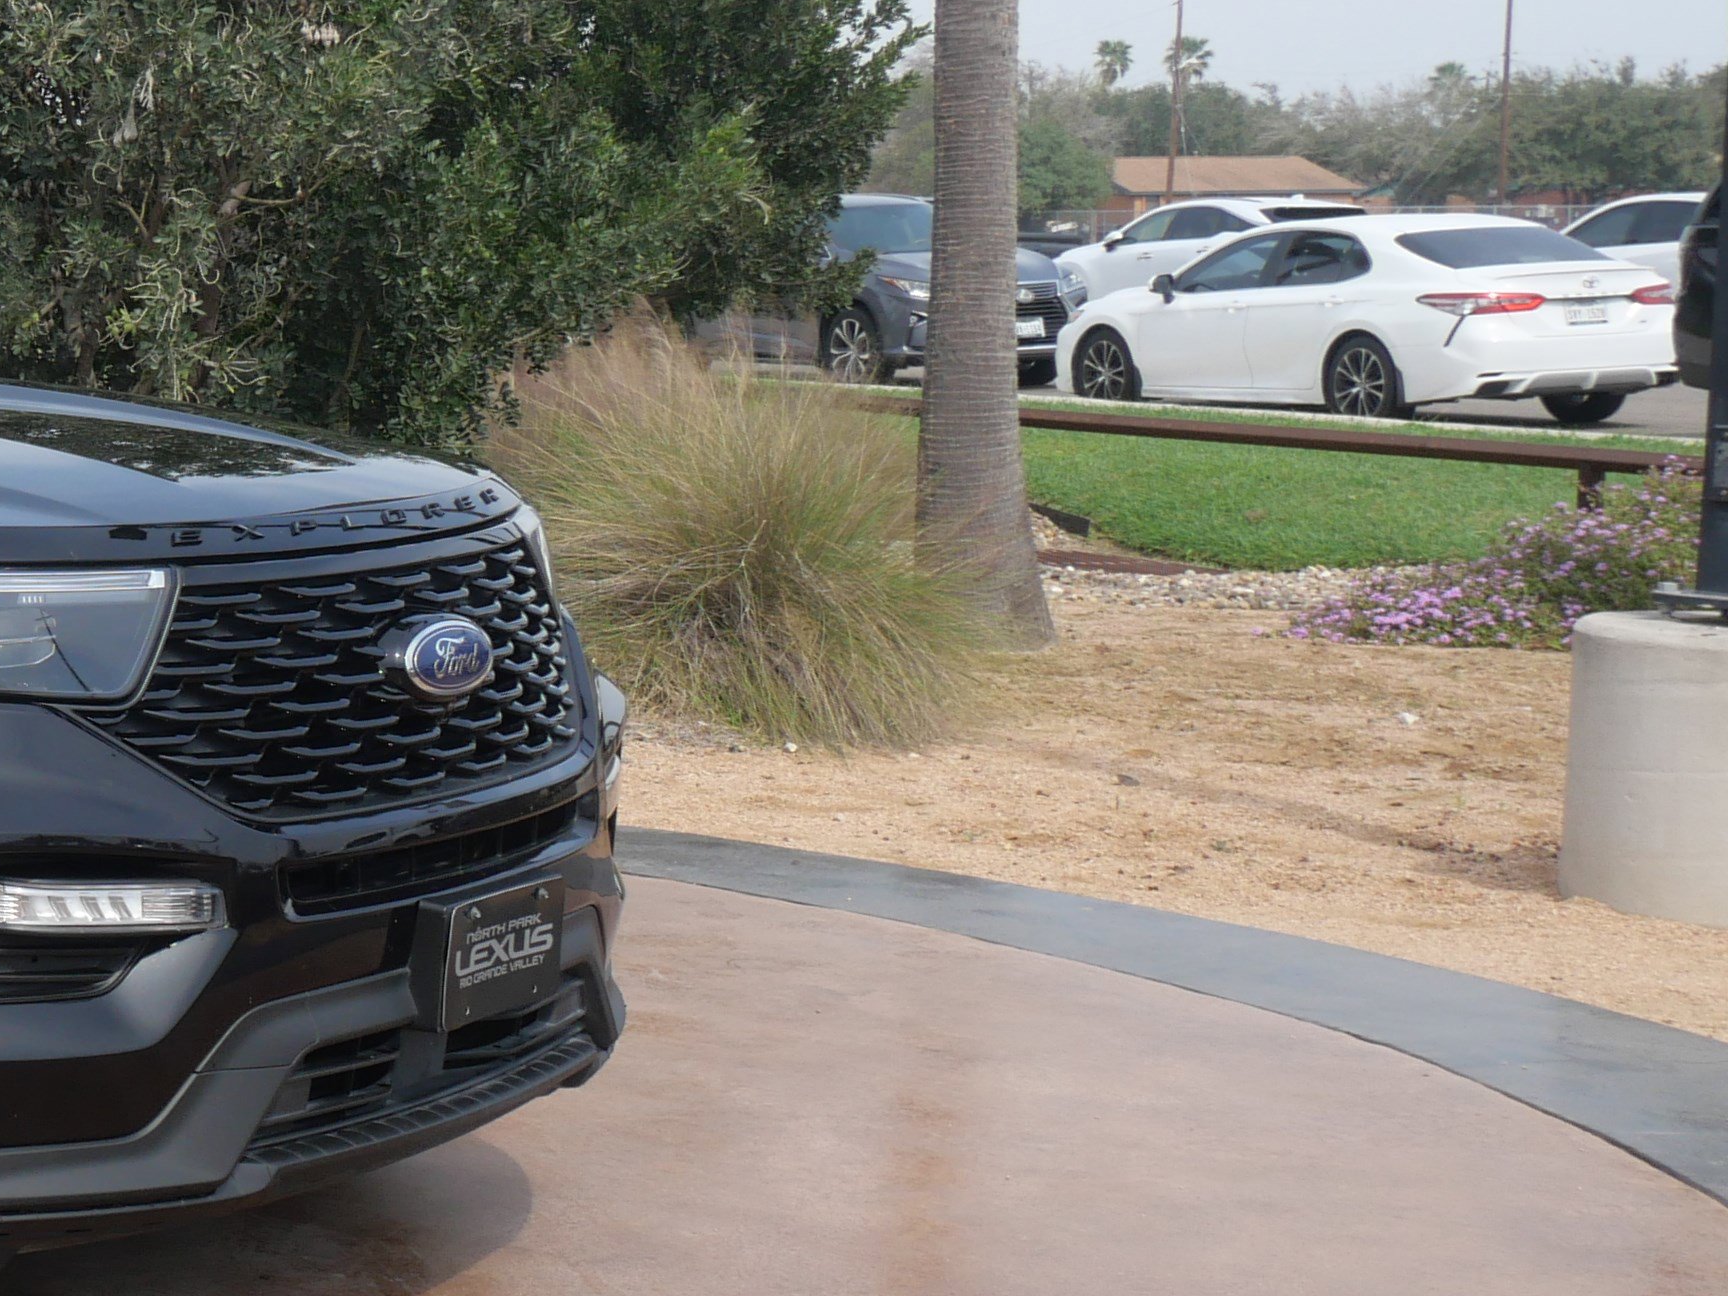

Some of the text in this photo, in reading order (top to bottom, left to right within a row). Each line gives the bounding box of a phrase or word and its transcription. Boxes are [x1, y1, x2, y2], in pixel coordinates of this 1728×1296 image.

[170, 488, 499, 547] EXPLORER
[433, 636, 480, 679] Ford
[455, 922, 554, 977] LEXUS
[466, 912, 542, 945] NORTH PARK
[473, 964, 508, 984] GRANDE
[509, 953, 545, 973] VALLEY
